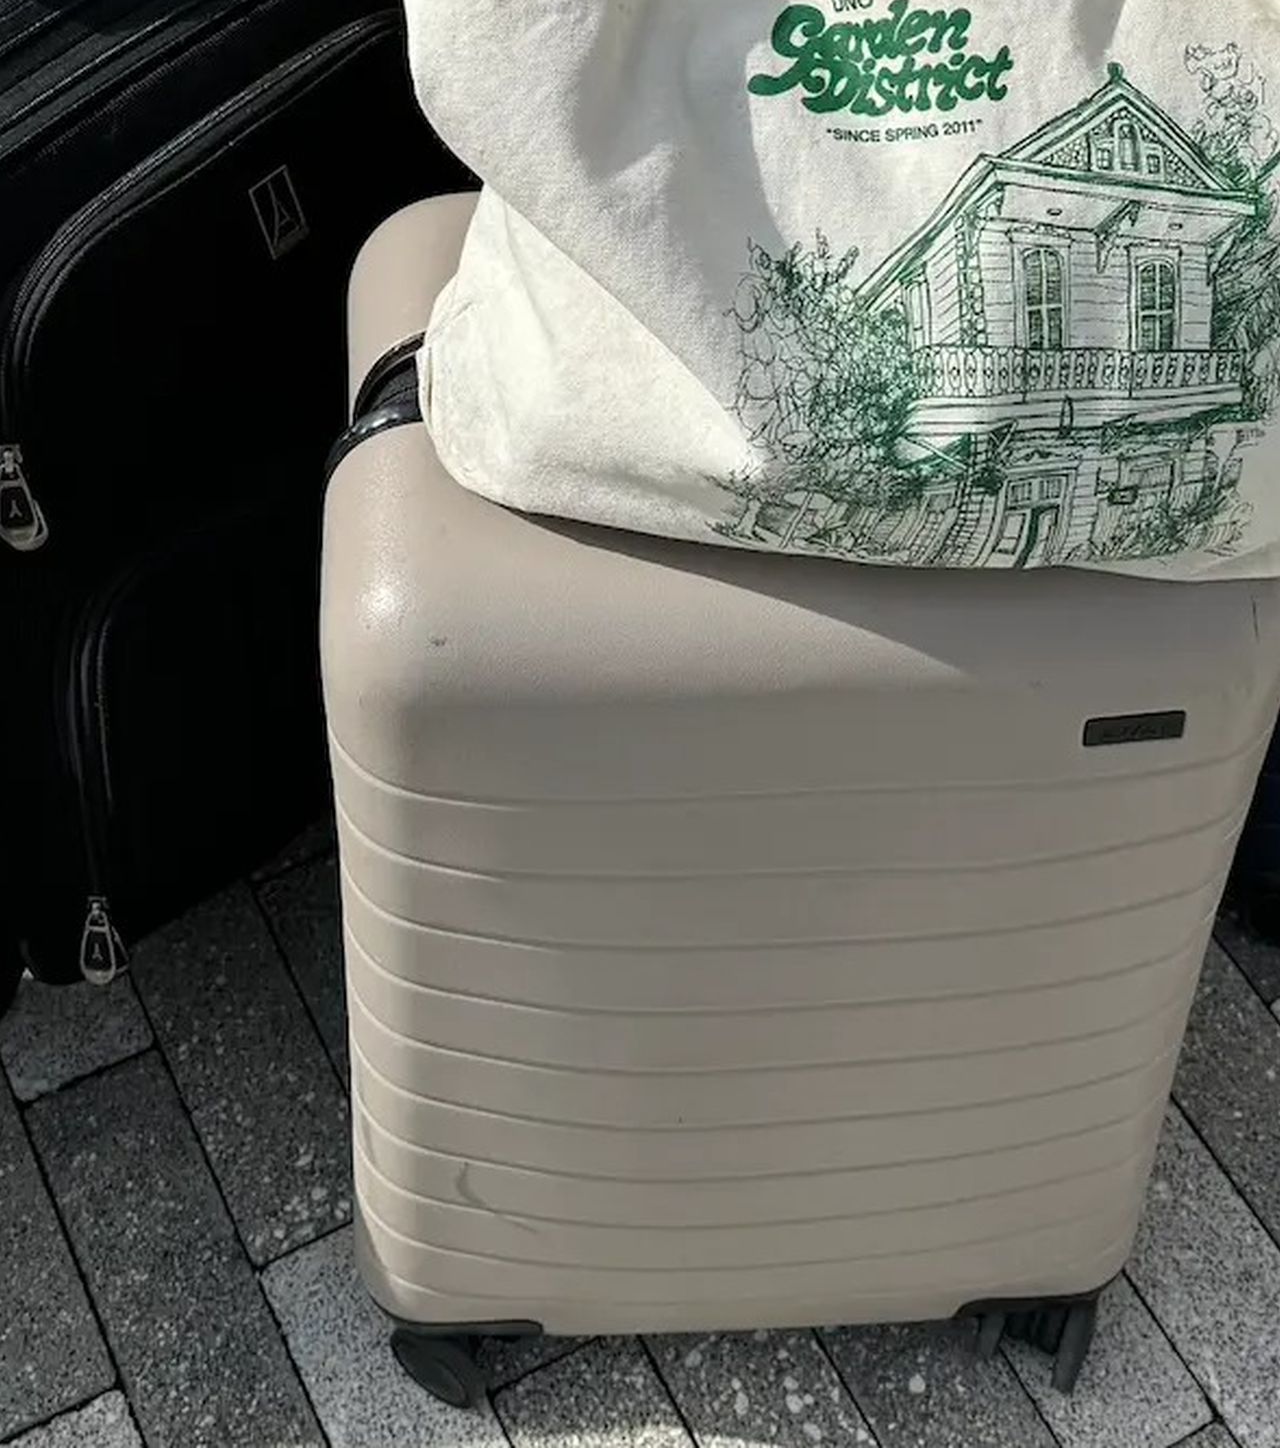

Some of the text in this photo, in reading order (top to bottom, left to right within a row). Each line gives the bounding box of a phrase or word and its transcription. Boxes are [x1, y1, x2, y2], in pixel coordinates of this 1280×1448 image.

[802, 43, 1014, 117] District
[826, 118, 984, 144] "SINCE SPRING 2011"
